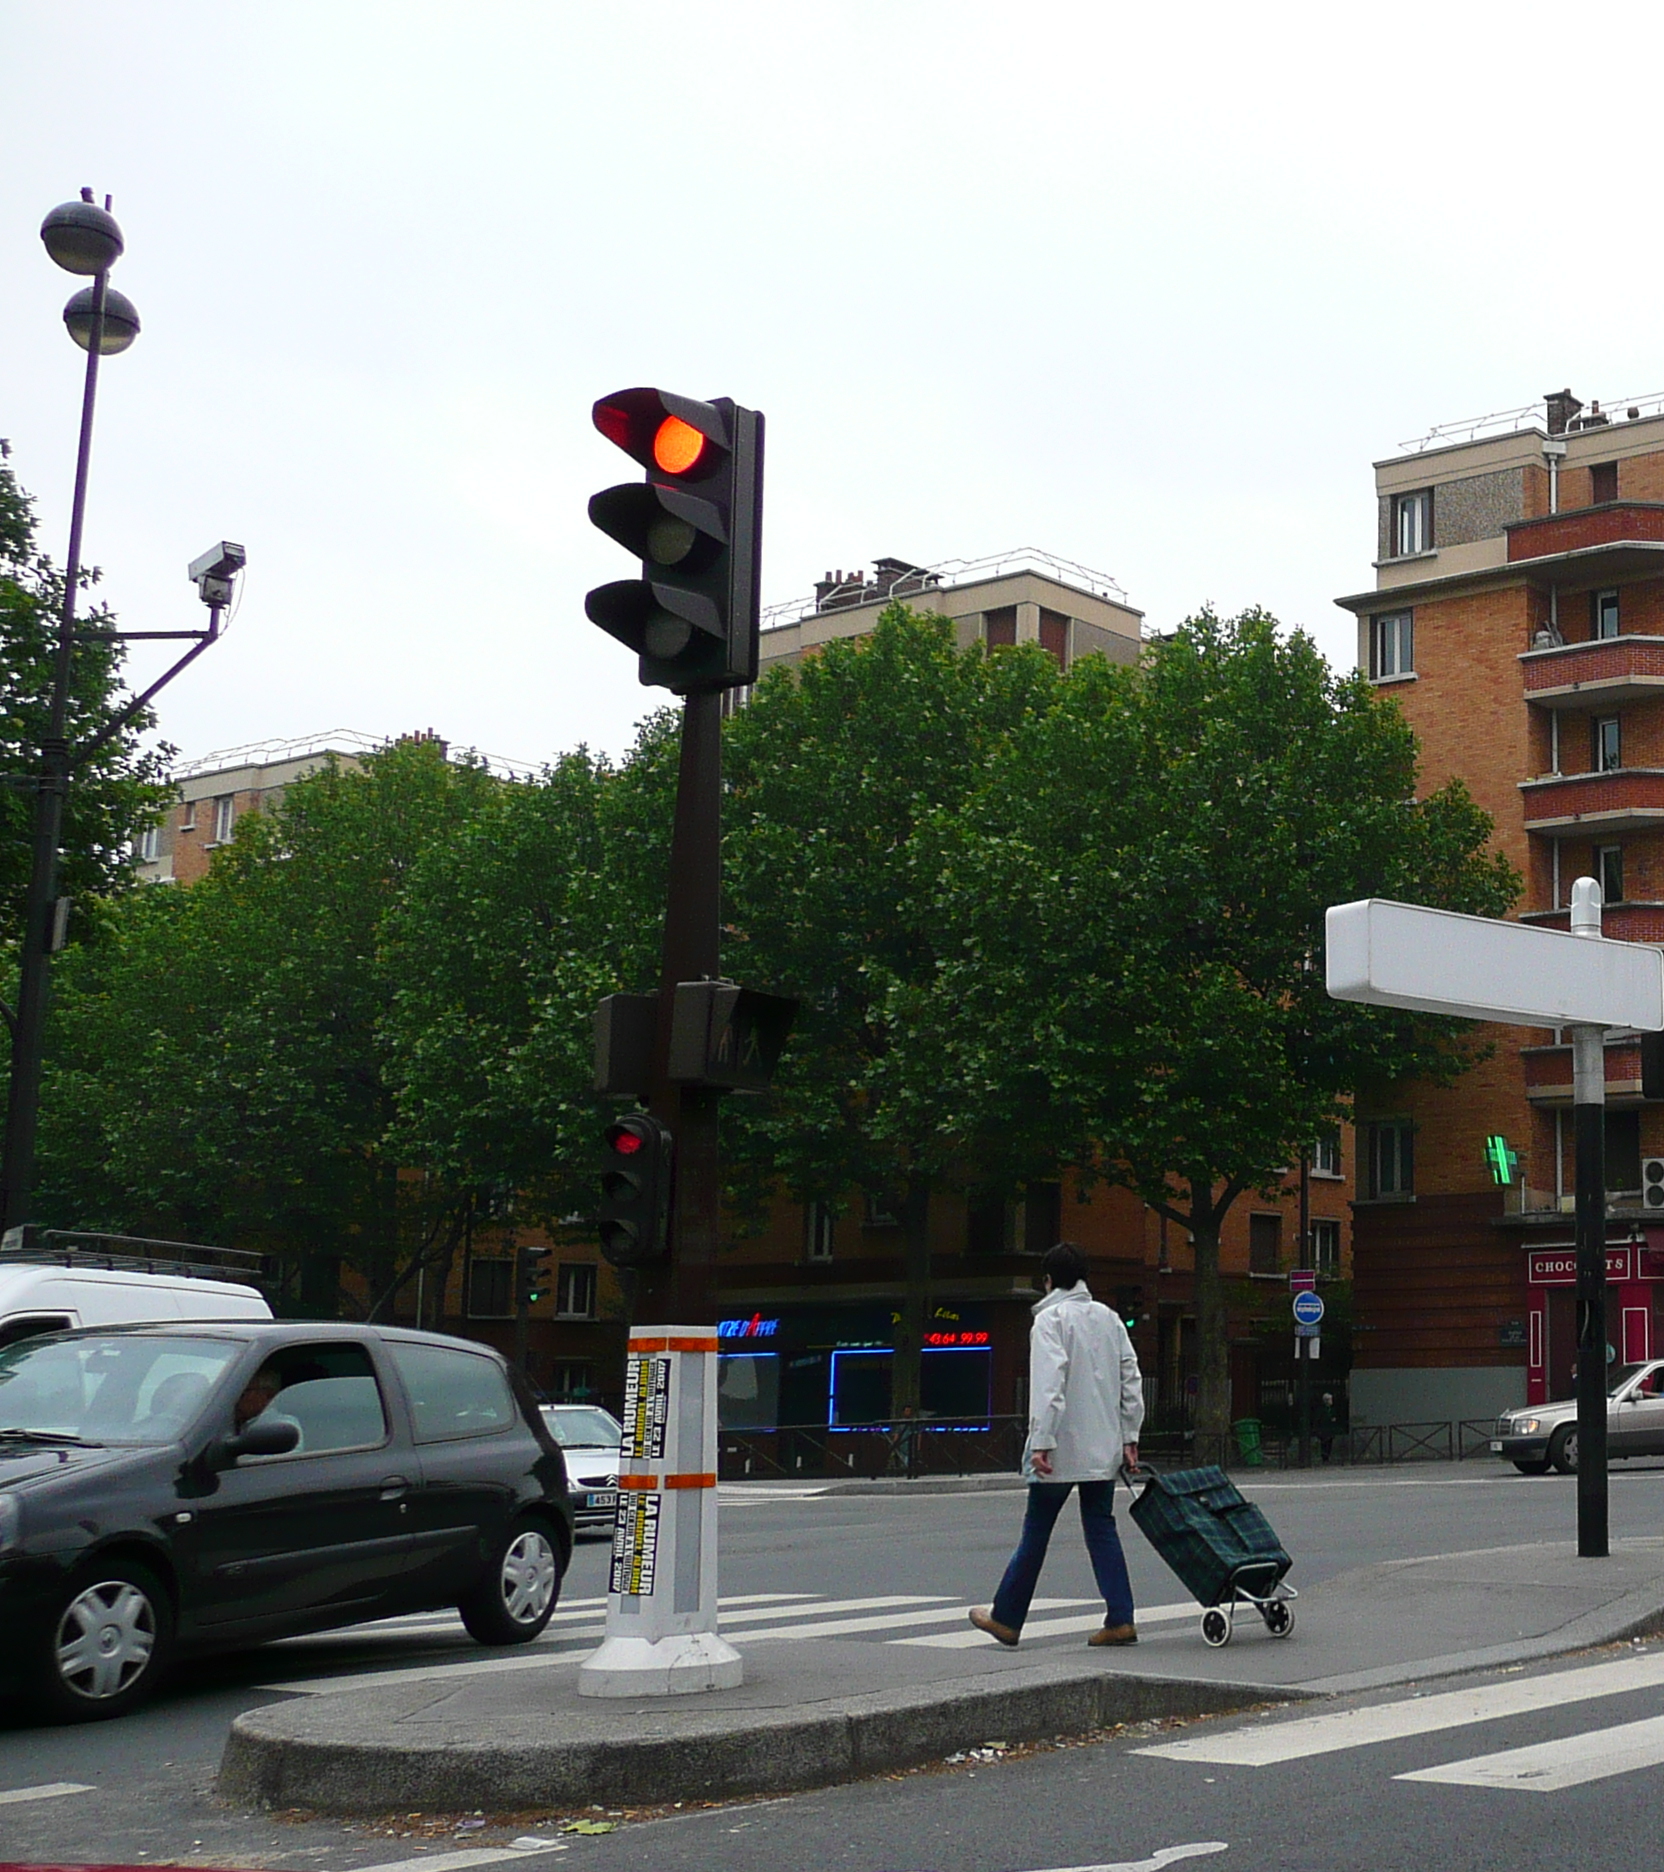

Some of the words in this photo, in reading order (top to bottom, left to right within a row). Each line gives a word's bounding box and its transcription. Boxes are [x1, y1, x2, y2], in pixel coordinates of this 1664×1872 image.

[639, 1360, 648, 1397] ALBUM
[657, 1360, 666, 1389] 2007
[623, 1360, 640, 1433] RUMEUR
[654, 1392, 664, 1424] AVRIL
[636, 1402, 645, 1441] NOUVEL
[653, 1426, 661, 1442] 23
[621, 1435, 635, 1457] LA
[635, 1445, 643, 1457] LE
[652, 1444, 660, 1457] LE
[620, 1495, 628, 1506] LE
[637, 1495, 646, 1506] LE
[645, 1495, 659, 1516] LA
[618, 1509, 626, 1525] 23
[635, 1510, 645, 1551] NOUVEL
[615, 1527, 625, 1559] AVRIL
[639, 1519, 657, 1595] RUMEUR
[612, 1561, 622, 1592] 2007
[630, 1555, 641, 1594] ALBUM
